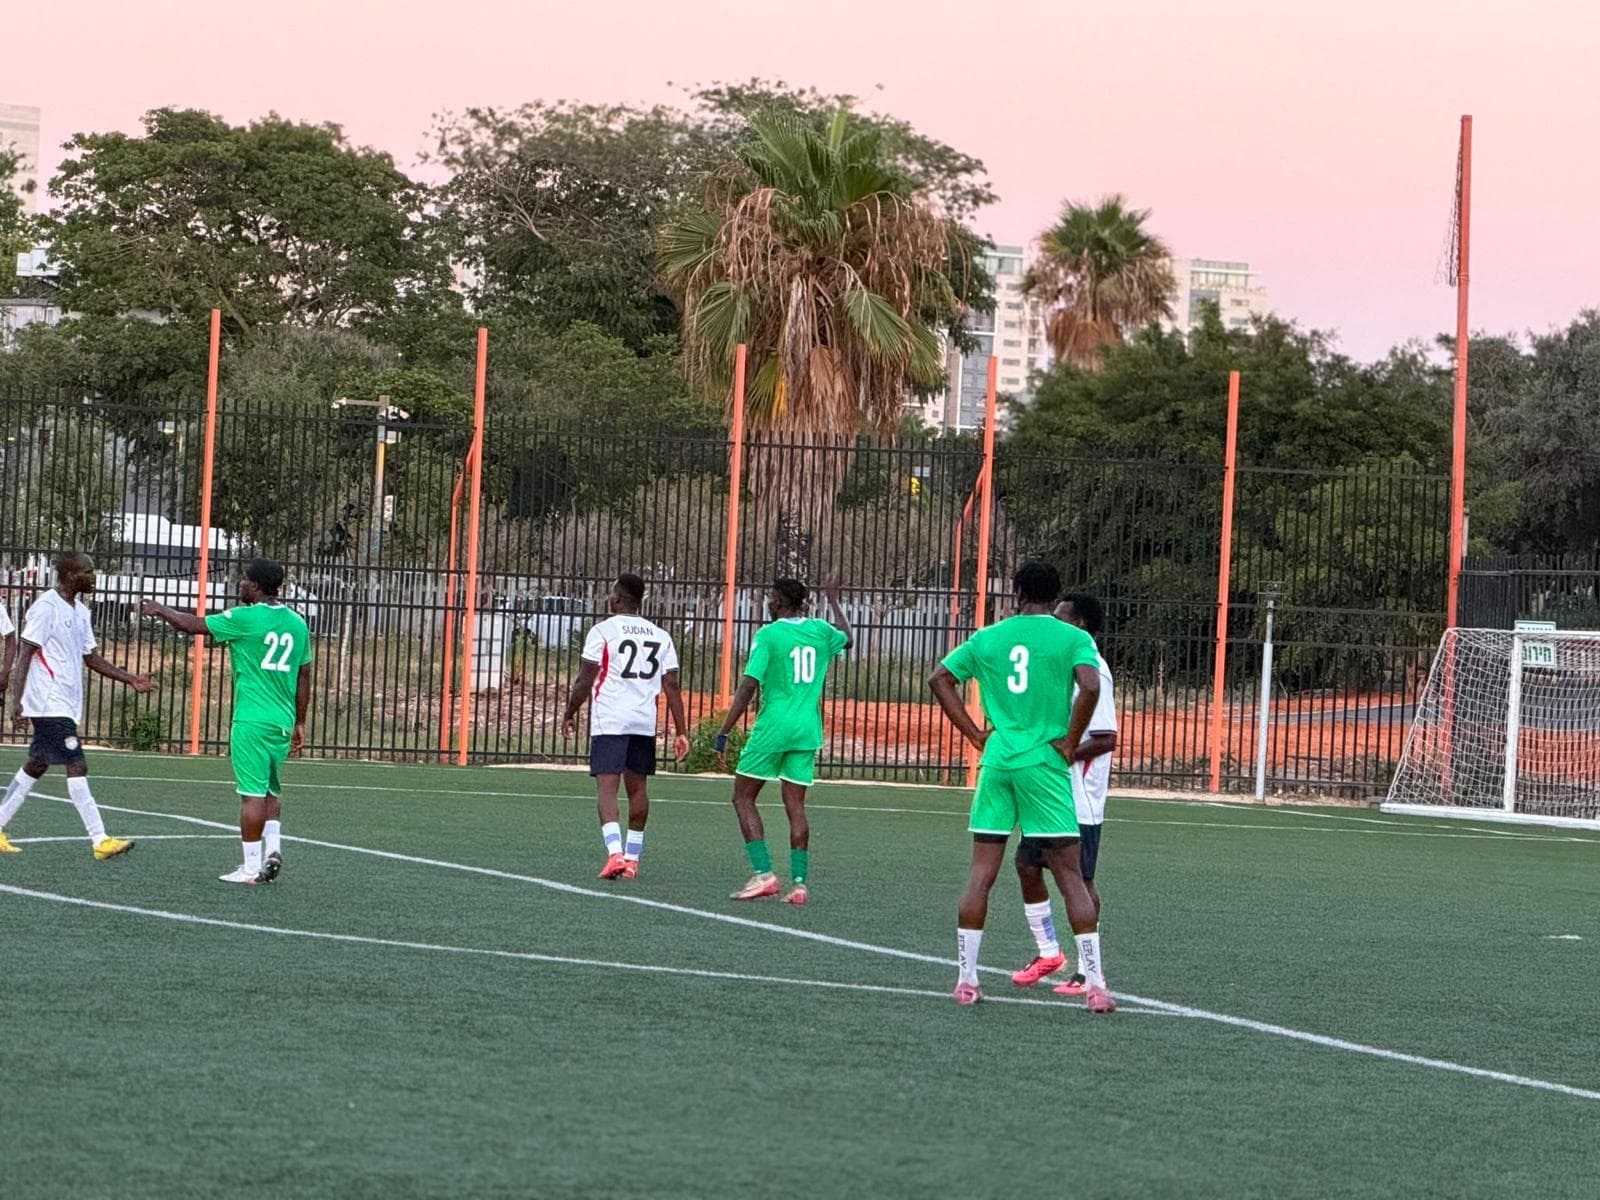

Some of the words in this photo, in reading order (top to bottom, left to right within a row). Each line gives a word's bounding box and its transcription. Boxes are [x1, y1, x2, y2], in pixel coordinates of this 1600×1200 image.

[622, 625, 653, 636] SUDAN
[261, 631, 293, 672] 22
[618, 639, 661, 680] 23
[789, 645, 816, 684] 10
[1007, 644, 1029, 694] 3
